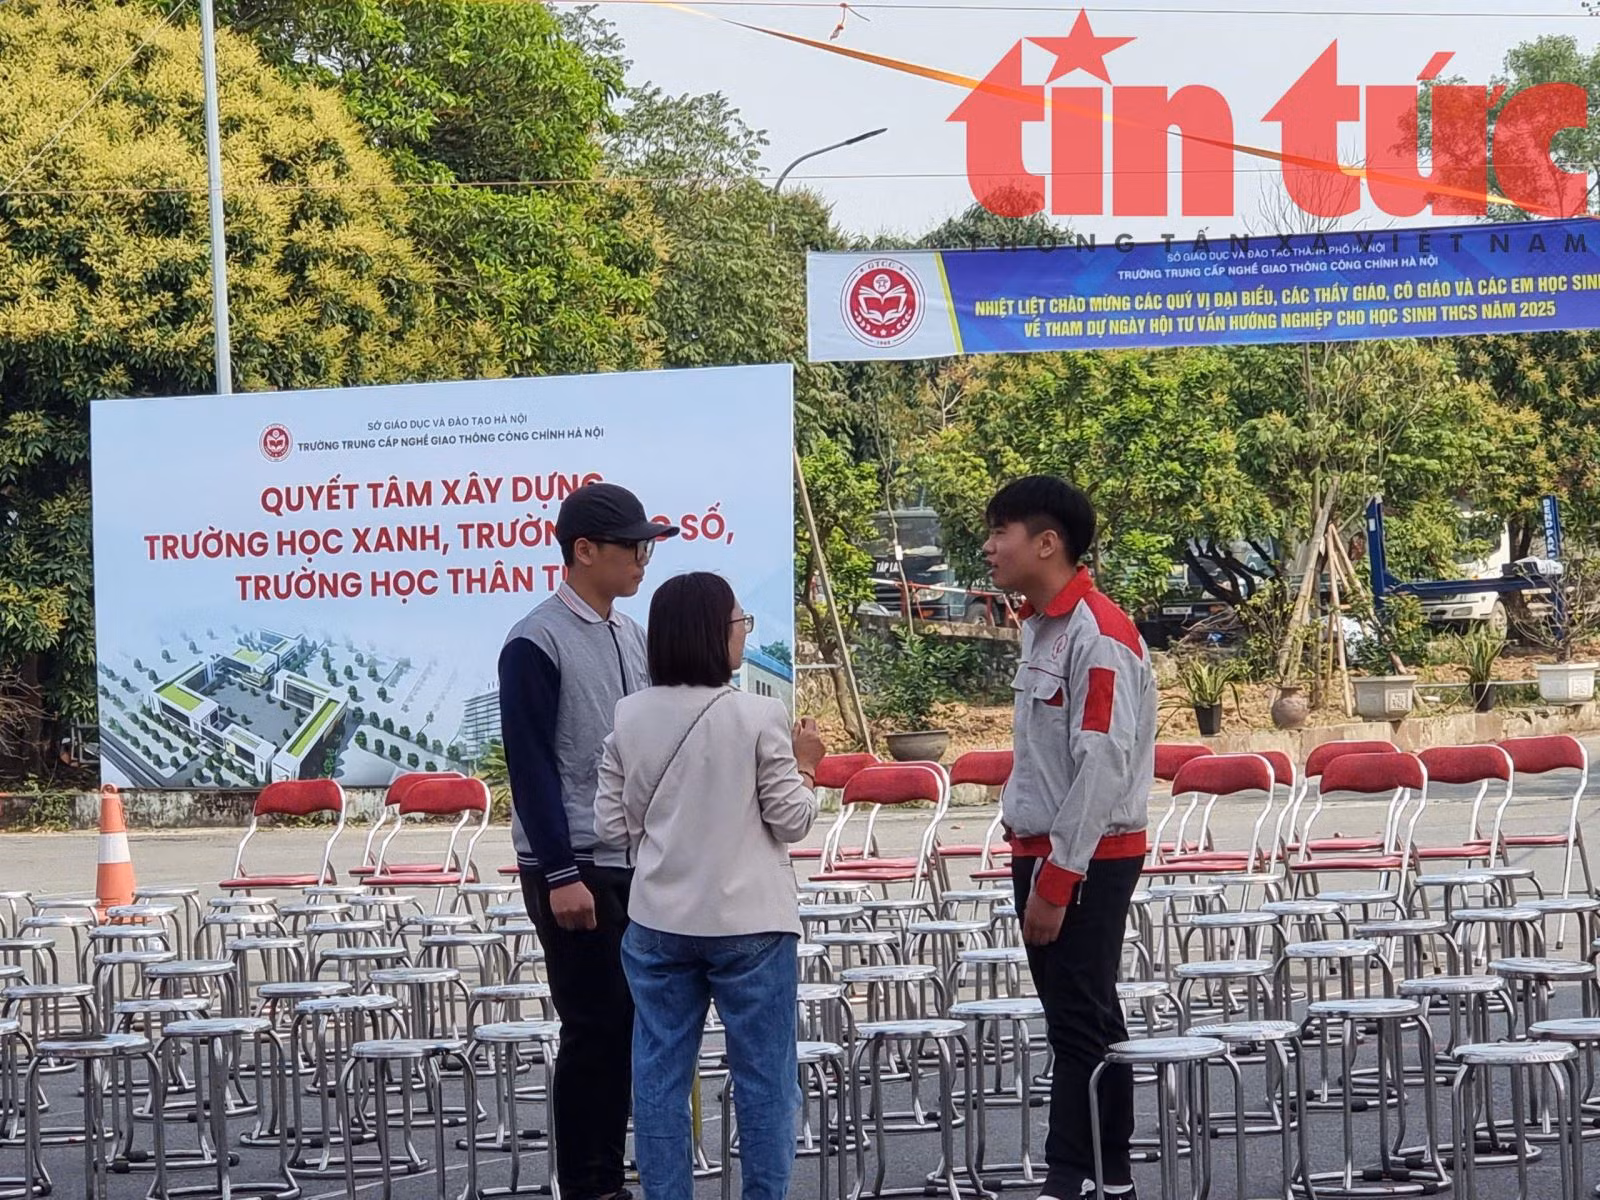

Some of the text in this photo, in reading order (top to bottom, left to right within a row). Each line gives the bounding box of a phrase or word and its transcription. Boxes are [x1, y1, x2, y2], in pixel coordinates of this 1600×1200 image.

[1118, 266, 1162, 281] TRƯỜNG
[1164, 268, 1200, 278] TRUNG
[1204, 263, 1226, 276] CẤP
[1261, 264, 1288, 274] GIAO
[1290, 260, 1327, 272] THÔNG
[1330, 259, 1362, 271] CÔNG
[1364, 256, 1398, 269] CHÍNH
[1401, 255, 1416, 268] HÀ
[1420, 256, 1438, 268] NỘI
[1232, 248, 1245, 260] VÀ
[1248, 247, 1268, 259] ĐÀO
[975, 274, 1600, 319] NHIỆT LIỆT CHÀO MỪNG CÁC QUÝ VỊ ĐẠI BIỂU, CÁC THẦY GIÁO, CÔ GIÁO VÀ CÁC EM HỌC SIN
[1024, 300, 1556, 339] VỀ THAM DỰ NGÀY HỘI TƯ VẤN HƯỚNG NGHIỆP CHO HỌC SINH THCS NĂM 2025
[298, 438, 340, 452] TRƯỜNG
[342, 439, 376, 450] TRUNG
[378, 436, 399, 448] CẤP
[430, 435, 456, 446] GIAO
[459, 430, 496, 444] THÔNG
[498, 430, 530, 442] CÔNG
[532, 428, 566, 440] CHÍNH
[568, 426, 582, 438] HÀ
[584, 426, 604, 440] NỘI
[368, 412, 528, 431] SỞ GIÁO DỤC VÀ ĐÀO TẠO HÀ NỘI
[261, 474, 360, 516] QUYẾT
[366, 475, 432, 508] TÂM
[441, 472, 503, 506] XÂY
[144, 526, 269, 560] TRƯỜNG
[276, 528, 344, 563] HỌC
[352, 525, 450, 556] XANH,
[680, 502, 734, 545] SỐ,
[236, 566, 362, 600] TRƯỜNG
[370, 569, 438, 604] HỌC
[447, 560, 533, 594] THÂN
